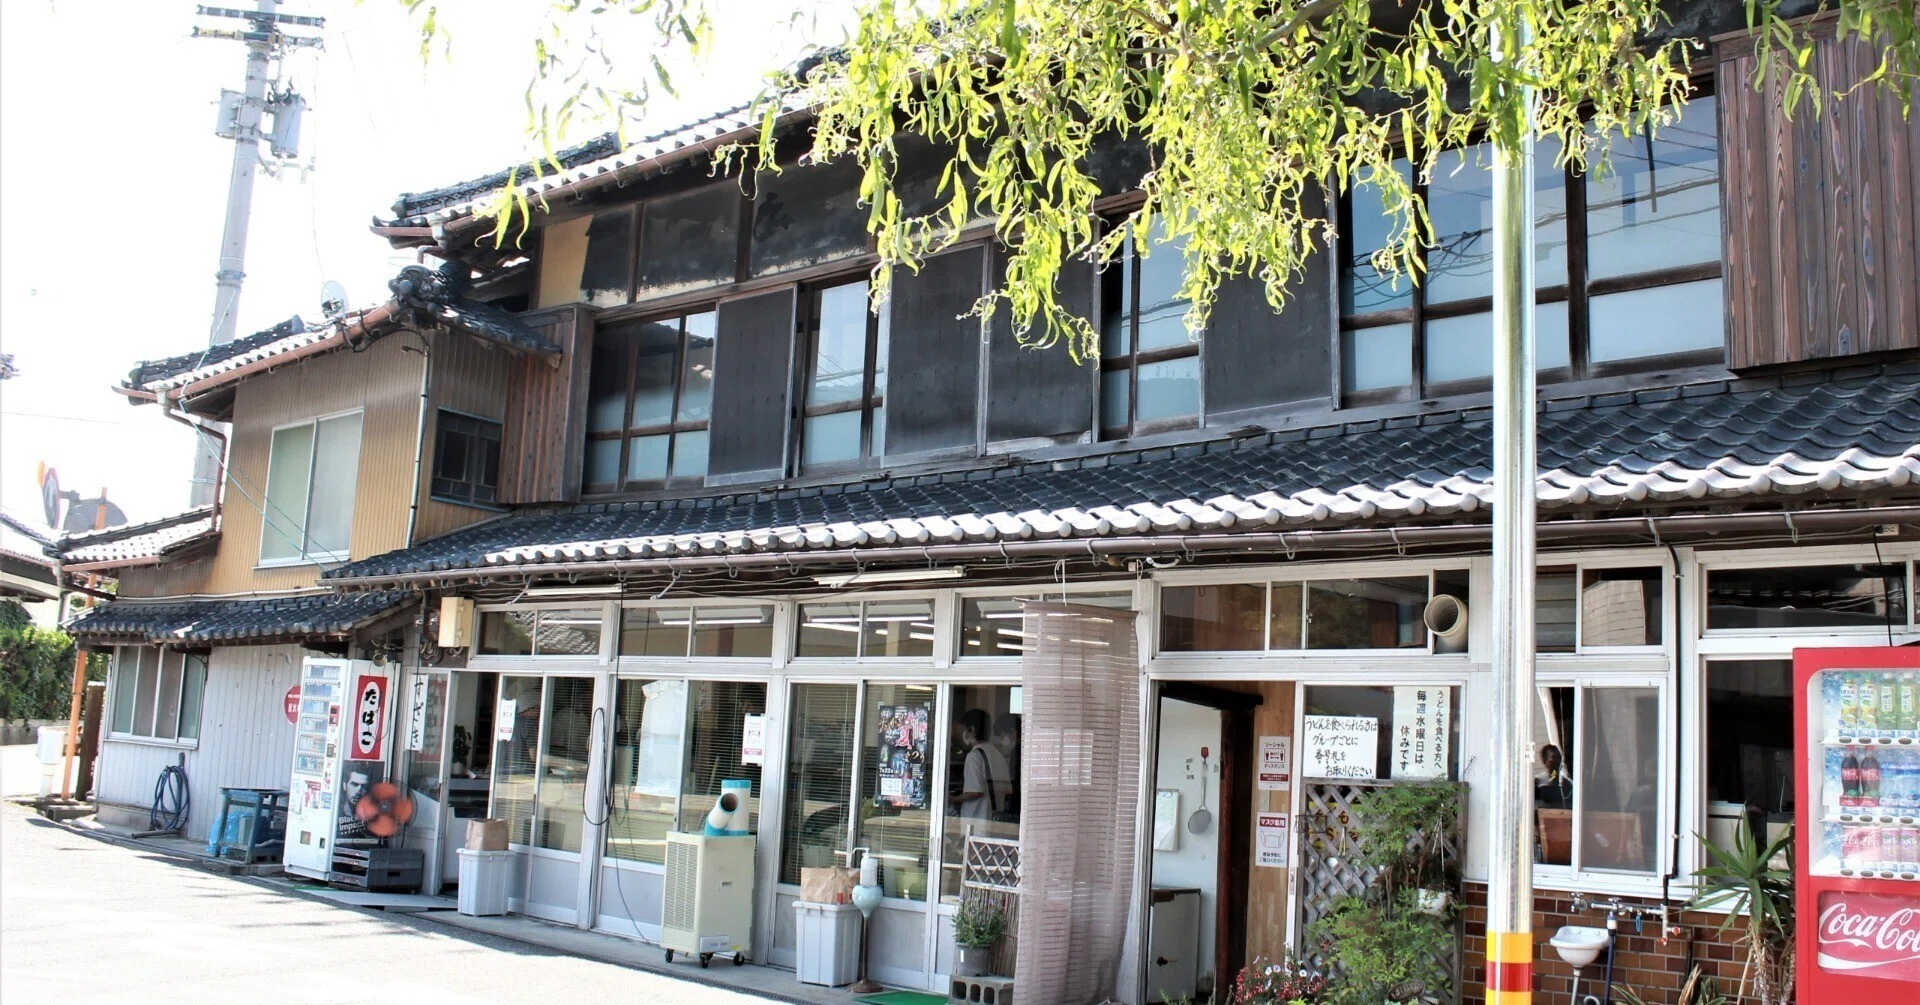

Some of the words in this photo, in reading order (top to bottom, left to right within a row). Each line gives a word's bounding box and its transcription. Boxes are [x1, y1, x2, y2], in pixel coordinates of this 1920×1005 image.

[361, 688, 379, 746] たばこ
[1305, 717, 1378, 732] うどんを食べられる方は
[1415, 690, 1427, 769] 毎週水曜日は、
[1434, 690, 1444, 769] うどんを食べる方へ
[1313, 733, 1359, 746] グループごとに
[1315, 749, 1347, 762] 番号札を
